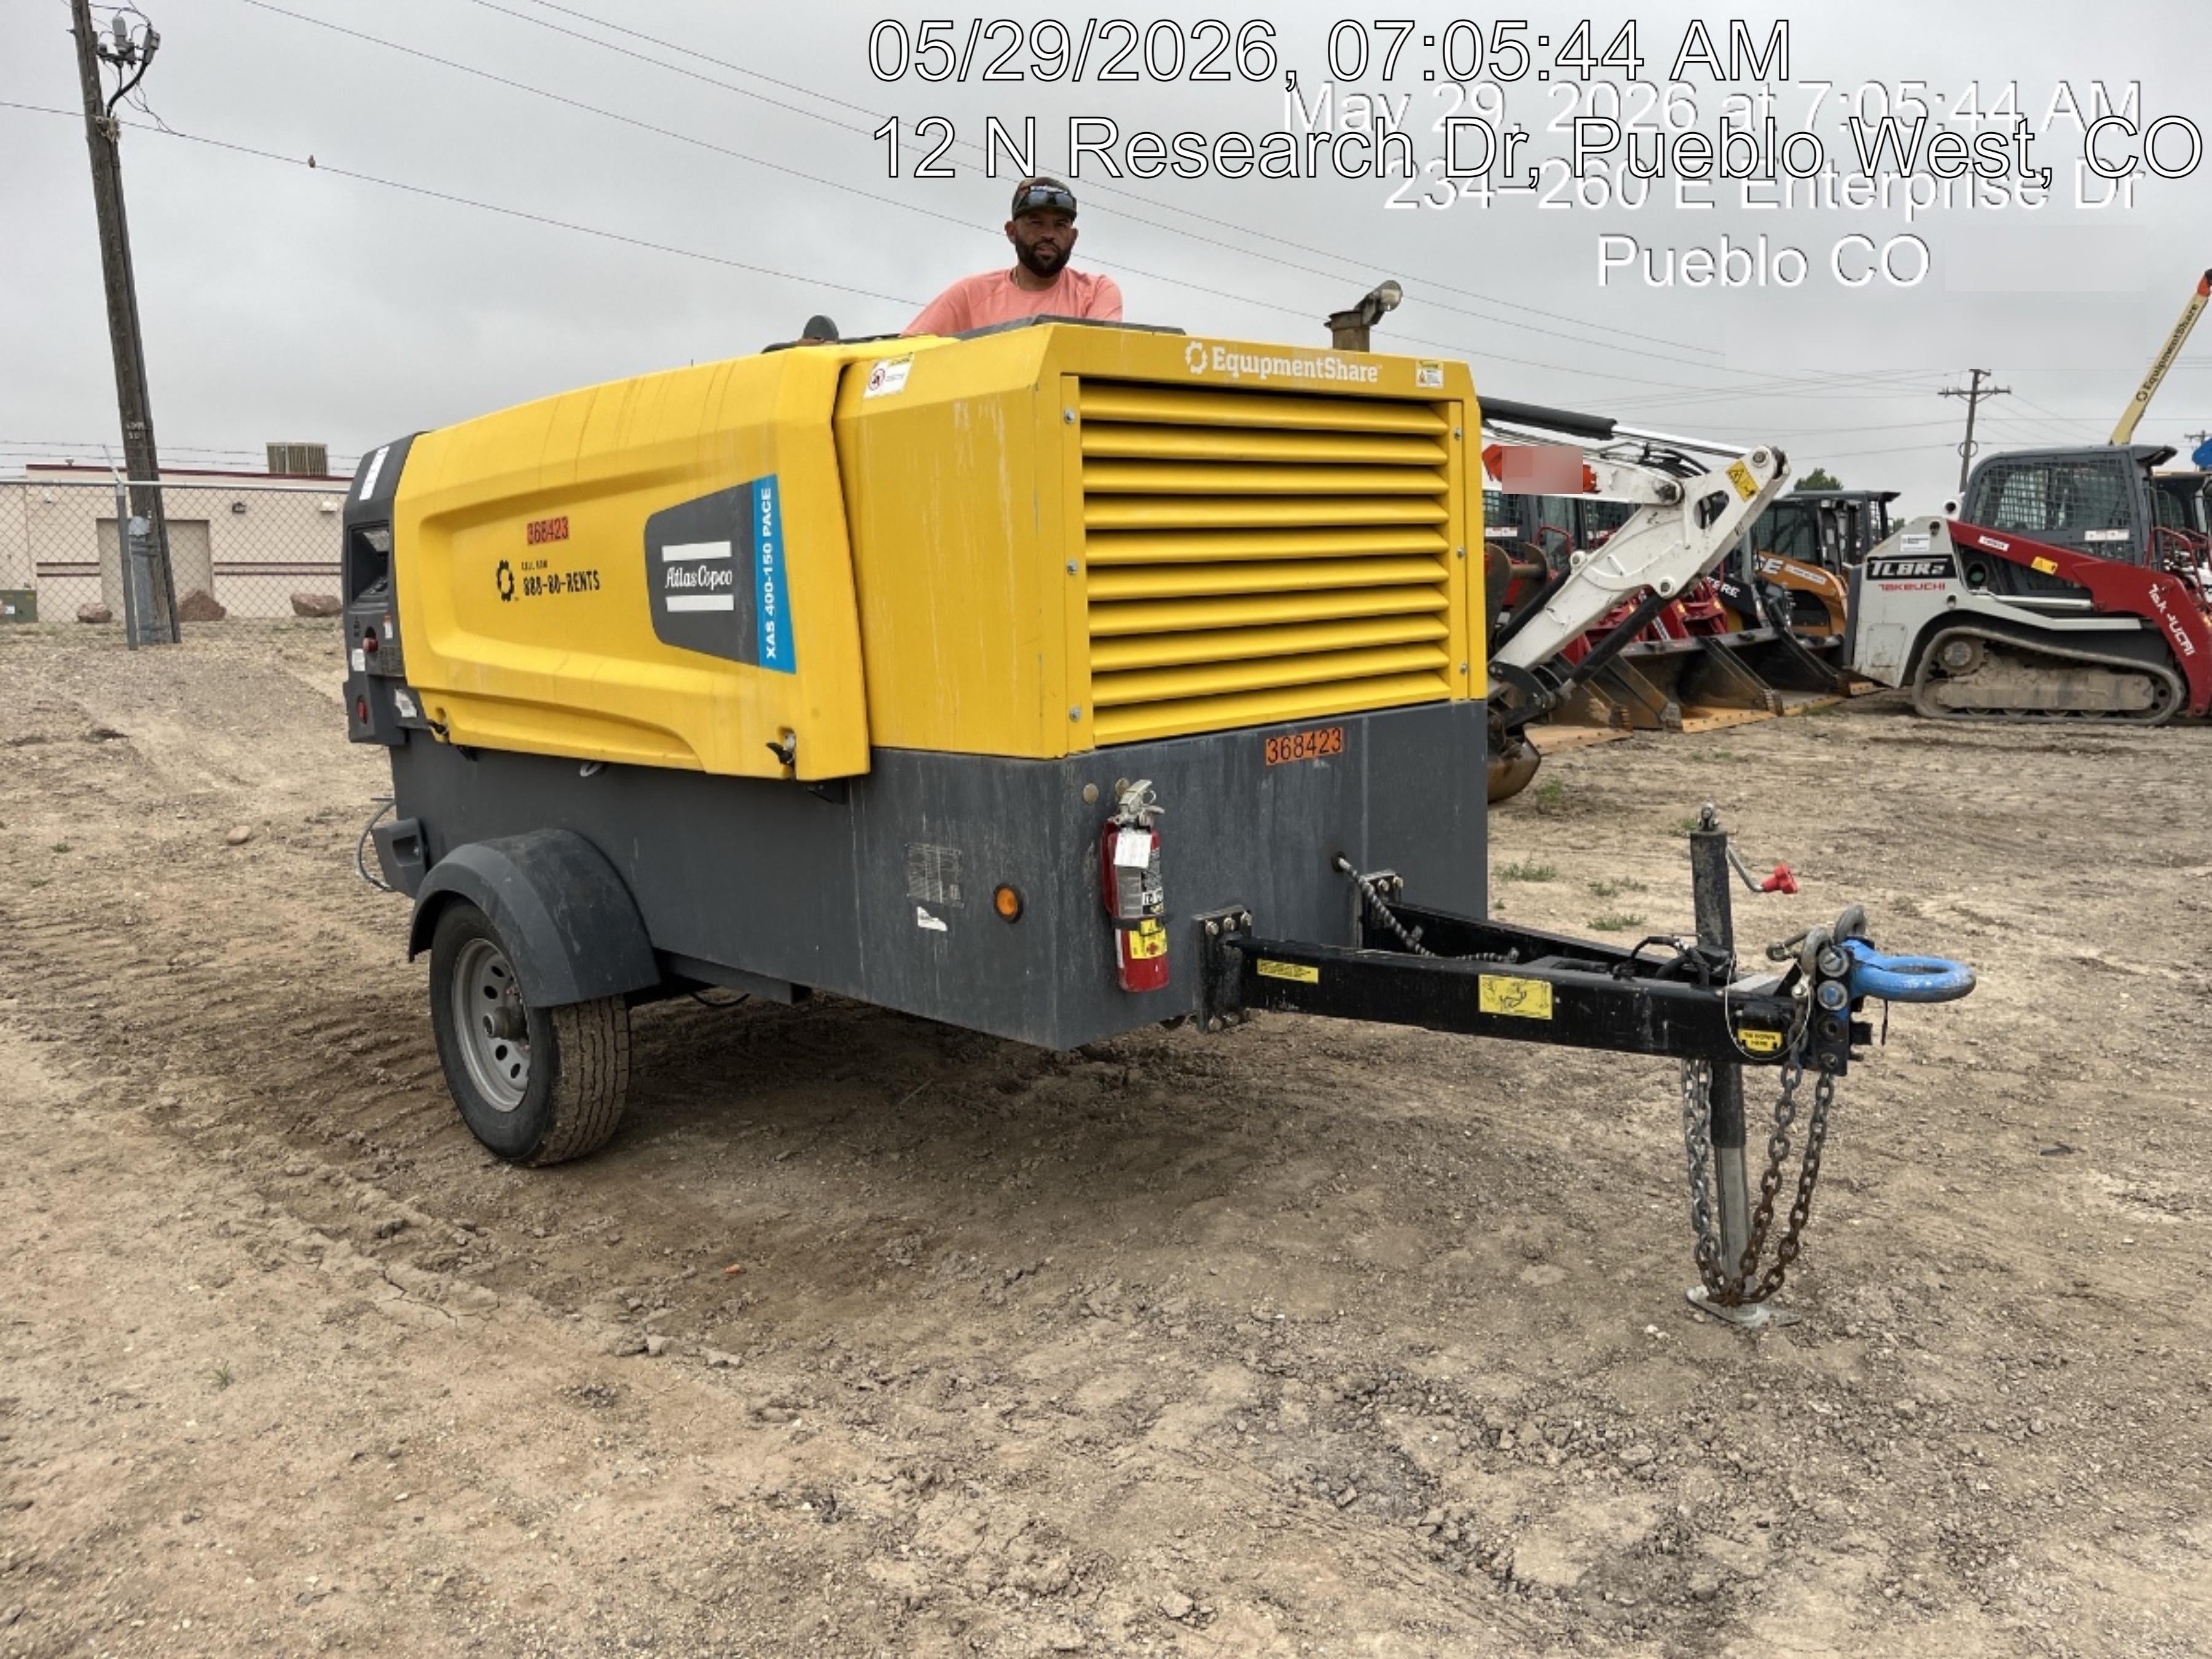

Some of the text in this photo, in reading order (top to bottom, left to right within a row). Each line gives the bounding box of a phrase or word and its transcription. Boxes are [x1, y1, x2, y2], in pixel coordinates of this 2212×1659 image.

[1212, 345, 1379, 382] EquipmentShare
[2143, 304, 2199, 390] EquipmentShare
[527, 516, 568, 545] 368423
[761, 488, 777, 659] XAS 400-150 PACE
[1878, 582, 1946, 591] TAKEUCHI
[1267, 727, 1341, 764] 368423
